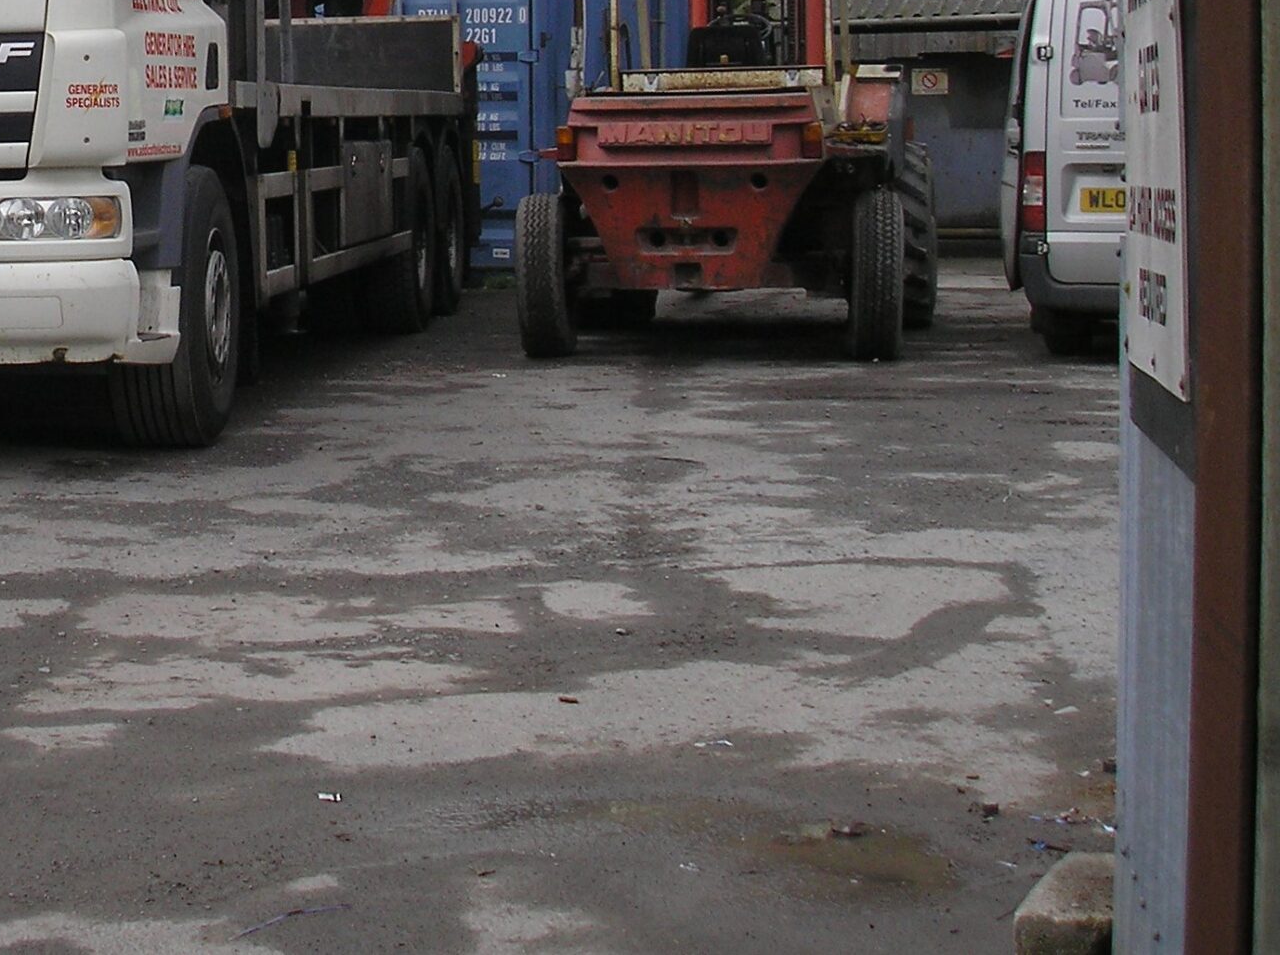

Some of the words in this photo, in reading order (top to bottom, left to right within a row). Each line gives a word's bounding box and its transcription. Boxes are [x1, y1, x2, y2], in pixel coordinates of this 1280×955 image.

[465, 8, 512, 24] 200922
[144, 31, 182, 58] GENERATOR
[183, 35, 197, 58] HIRE
[145, 64, 168, 89] SALES
[173, 67, 198, 90] SERVICE
[68, 84, 119, 95] GENERATOR
[66, 97, 120, 108] SPECIALISTS
